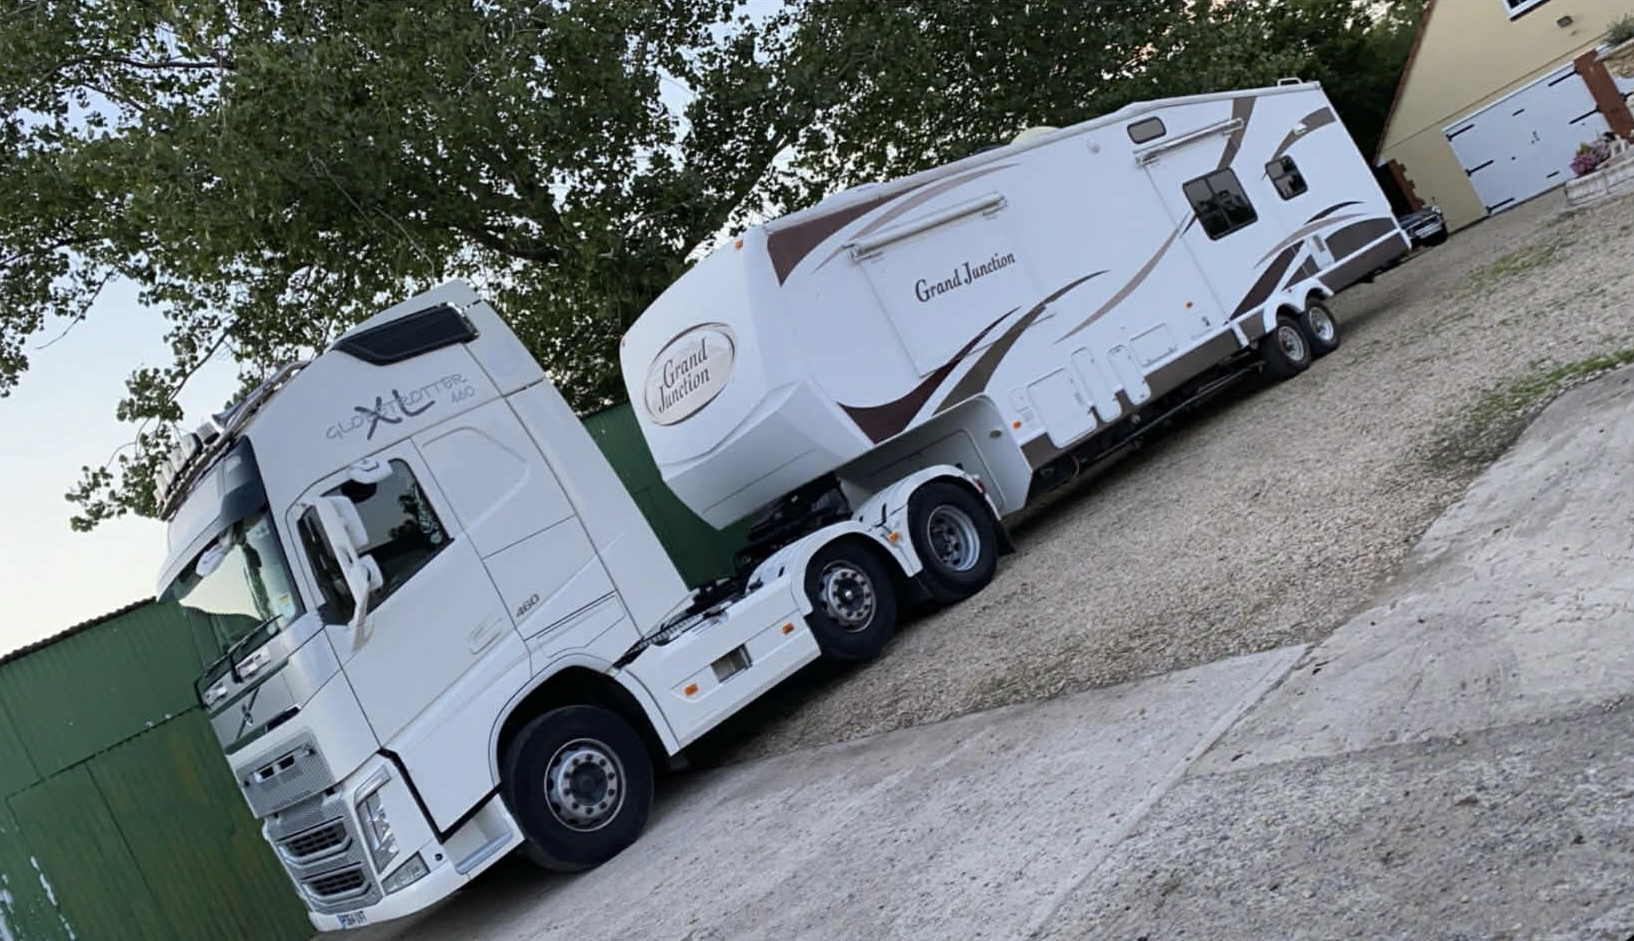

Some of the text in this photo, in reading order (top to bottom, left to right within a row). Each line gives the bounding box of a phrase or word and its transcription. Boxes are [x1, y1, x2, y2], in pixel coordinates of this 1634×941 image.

[914, 252, 1015, 302] Grand Junction
[663, 337, 708, 389] Grand
[354, 389, 435, 440] XL
[658, 368, 710, 413] Junction
[516, 593, 539, 617] 460
